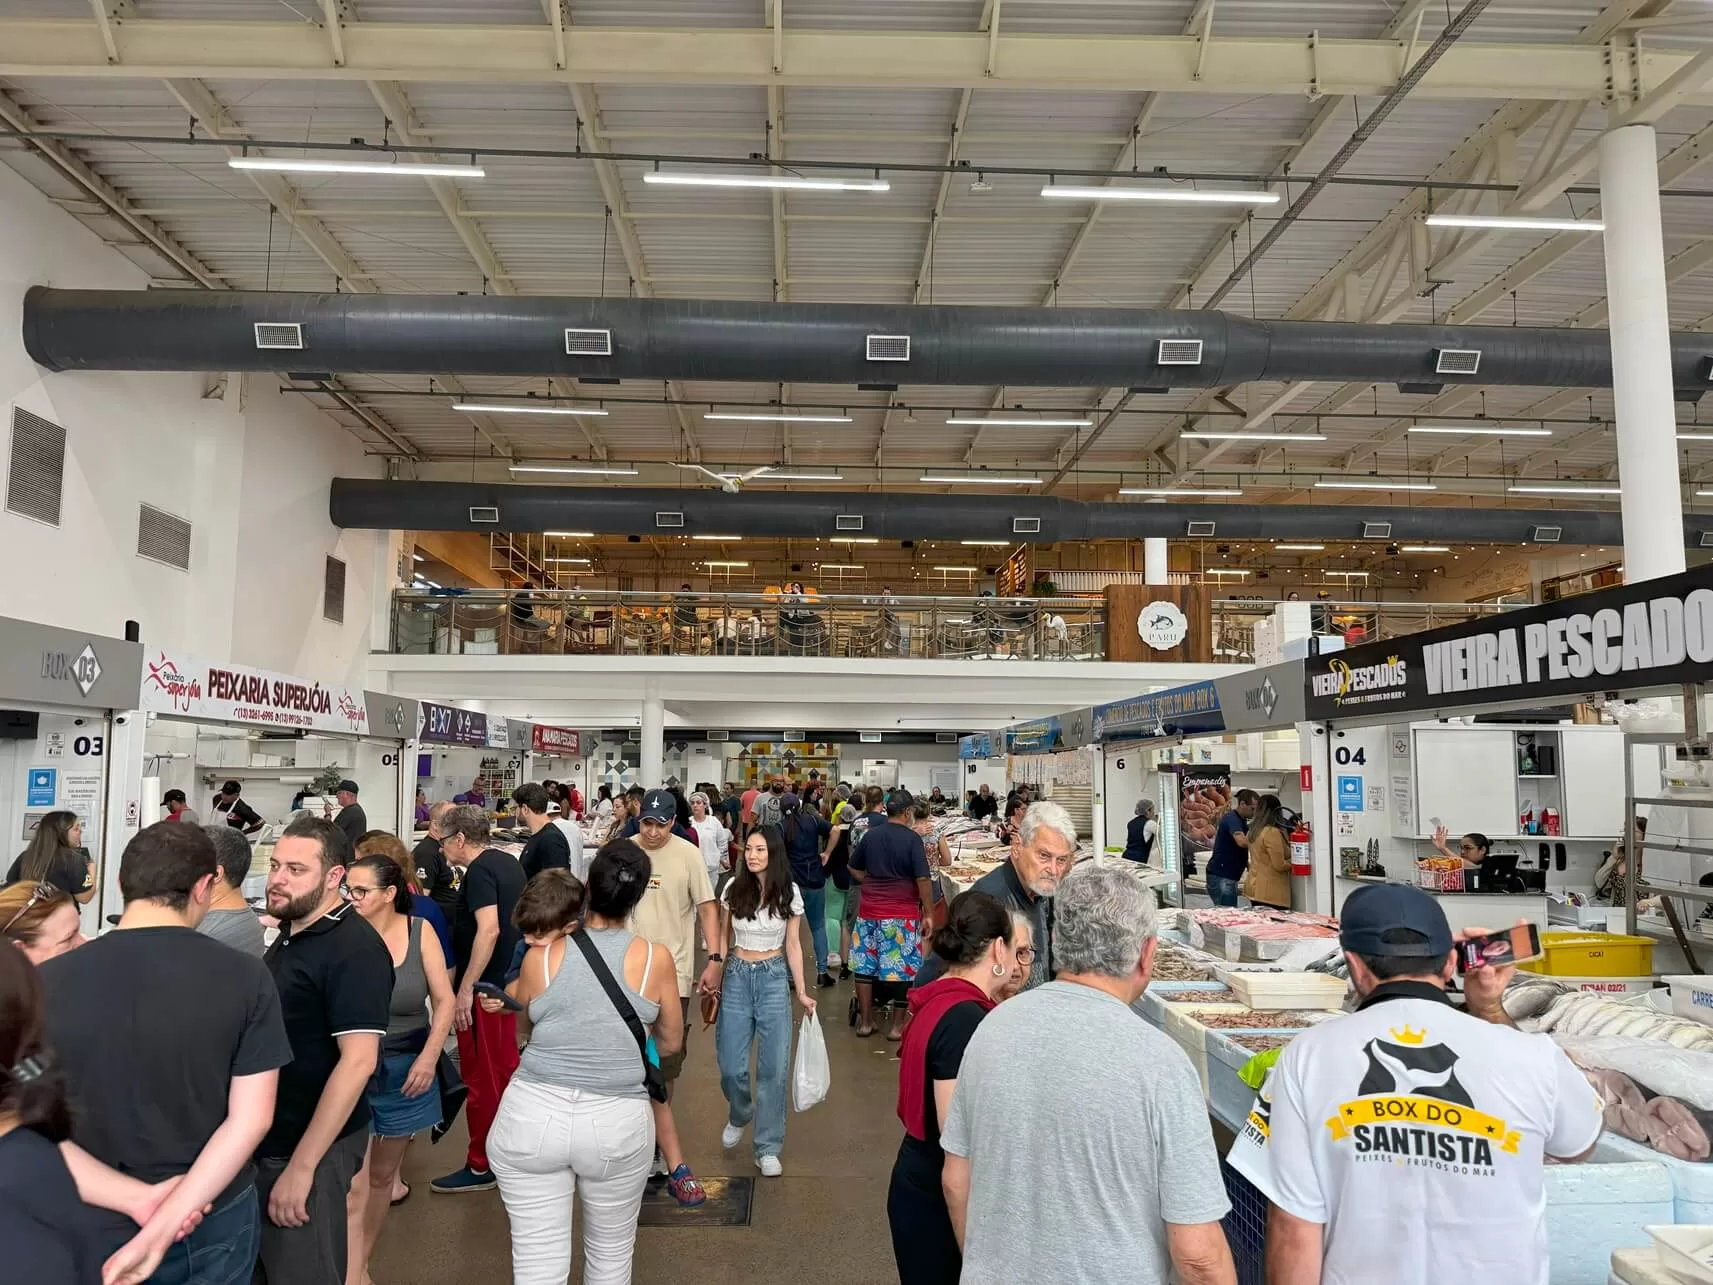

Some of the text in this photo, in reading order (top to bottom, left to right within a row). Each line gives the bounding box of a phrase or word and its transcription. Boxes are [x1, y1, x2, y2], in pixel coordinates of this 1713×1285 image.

[1149, 632, 1177, 641] PARU
[1422, 588, 1713, 695] VIEIRA PESCADO
[41, 650, 95, 682] BOX 03
[163, 671, 185, 682] Peixaria
[1312, 660, 1406, 697] VIEIRA PESCADOS
[167, 679, 201, 712] superjóia
[208, 668, 331, 714] PEIXARIA SUPERJÓIA
[1182, 691, 1195, 711] MAR
[1196, 688, 1208, 710] BOX
[1210, 686, 1215, 708] 6
[74, 736, 103, 756] 03
[1335, 746, 1366, 766] 04
[968, 764, 976, 774] 10
[1116, 758, 1125, 770] 6
[1253, 1118, 1265, 1130] DO
[1373, 1099, 1462, 1126] BOX DO
[1353, 1123, 1493, 1167] SANTISTA
[1355, 1154, 1496, 1177] PEIXES FRUTOS DO MAR
